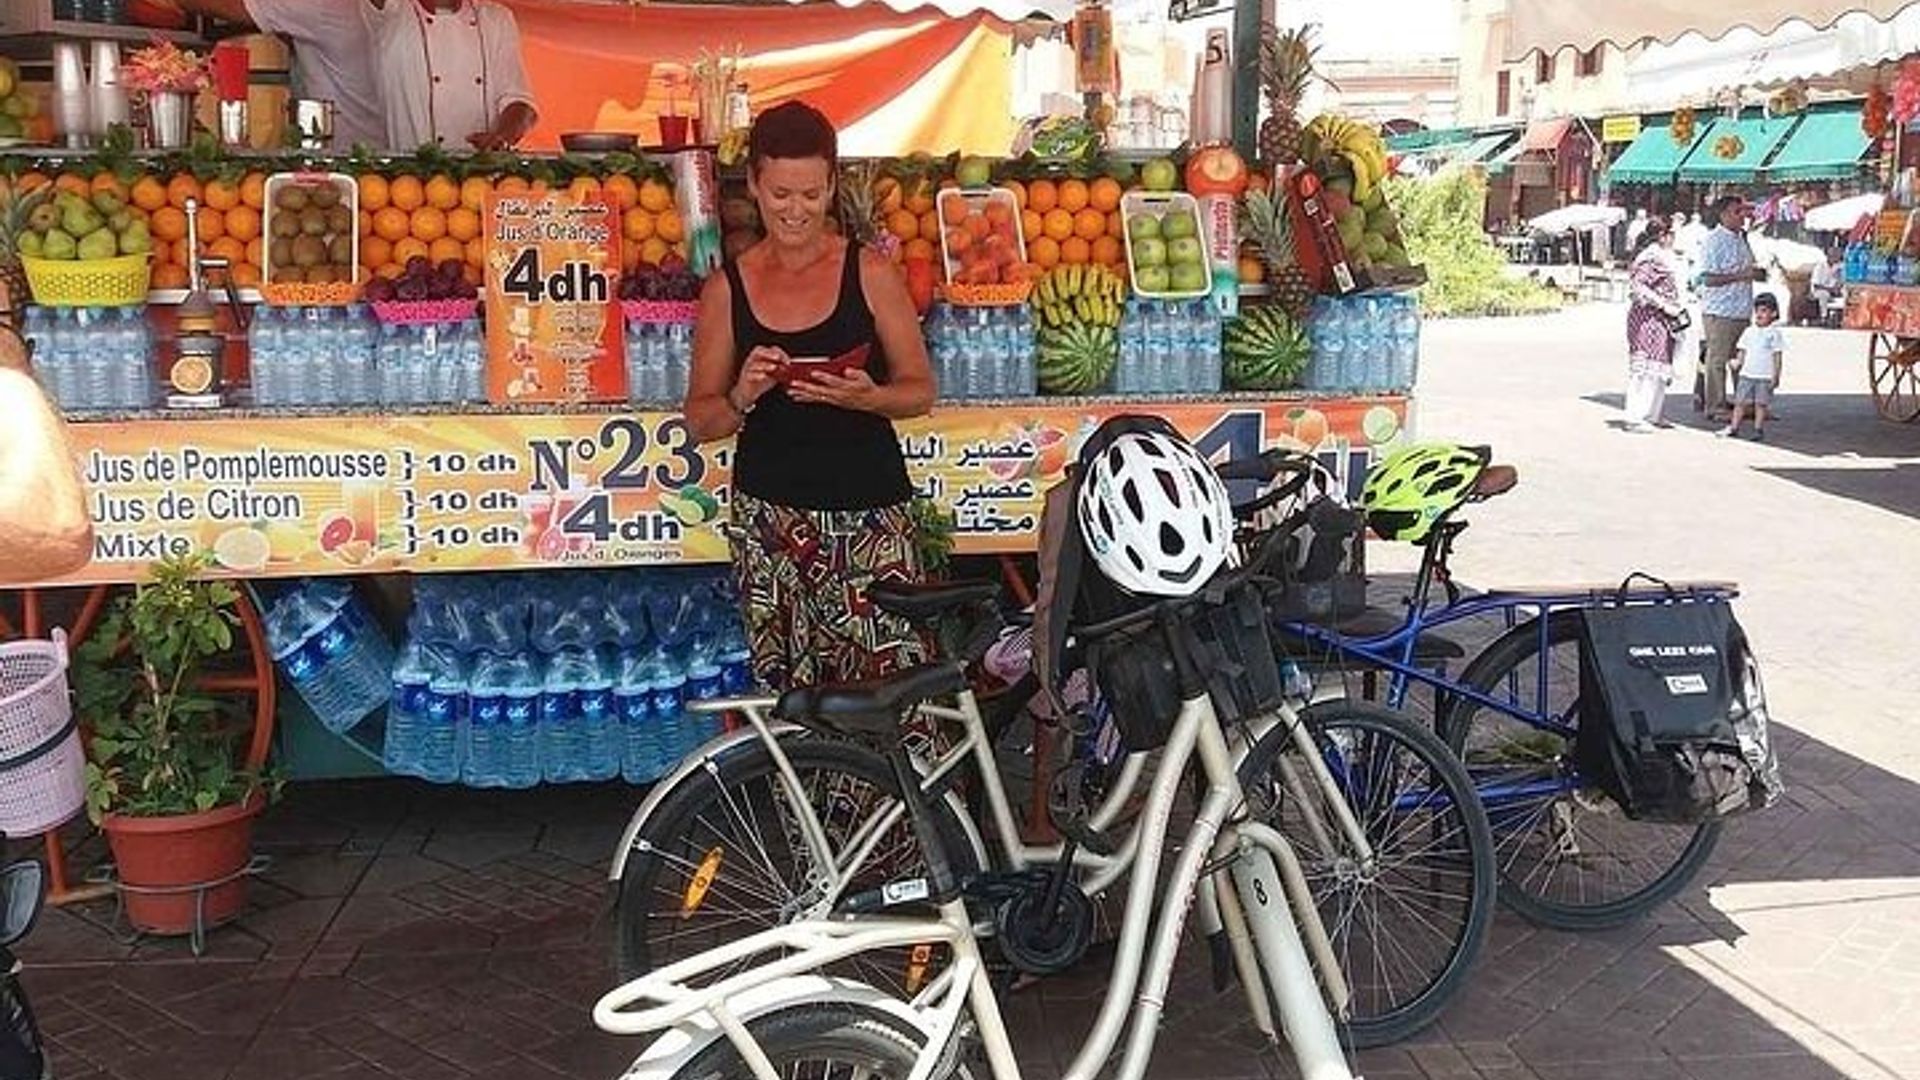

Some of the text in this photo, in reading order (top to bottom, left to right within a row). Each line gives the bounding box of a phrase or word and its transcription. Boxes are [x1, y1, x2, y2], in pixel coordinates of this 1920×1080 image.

[497, 224, 526, 241] Jus
[504, 248, 607, 301] 4dh
[88, 449, 388, 485] Jus de Pomplemousse
[427, 453, 517, 473] 10 dh
[955, 441, 1035, 467] عصير
[93, 489, 301, 523] Jus de Citron
[430, 493, 519, 511] 10 dh
[955, 481, 1034, 507] عصير
[563, 495, 680, 542] 4dh
[95, 533, 191, 560] Mixte
[432, 527, 519, 545] 10 dh
[1253, 877, 1269, 907] 8
